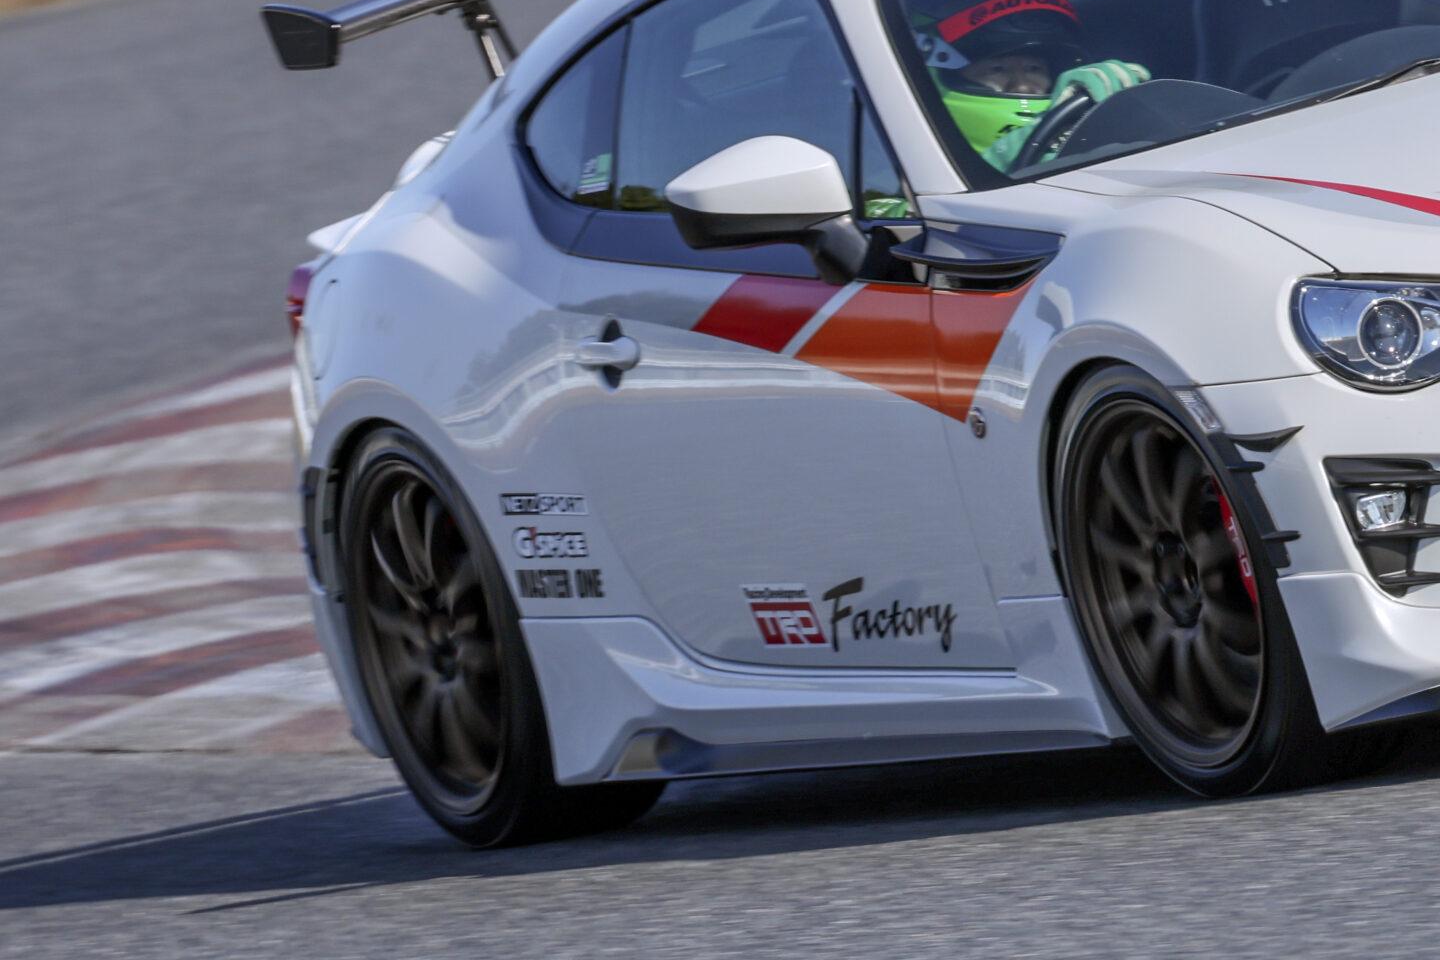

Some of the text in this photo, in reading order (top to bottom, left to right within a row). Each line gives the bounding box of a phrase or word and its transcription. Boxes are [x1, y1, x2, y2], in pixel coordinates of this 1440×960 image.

[575, 569, 605, 598] ONE
[753, 609, 821, 644] TRD
[822, 576, 957, 652] Factory
